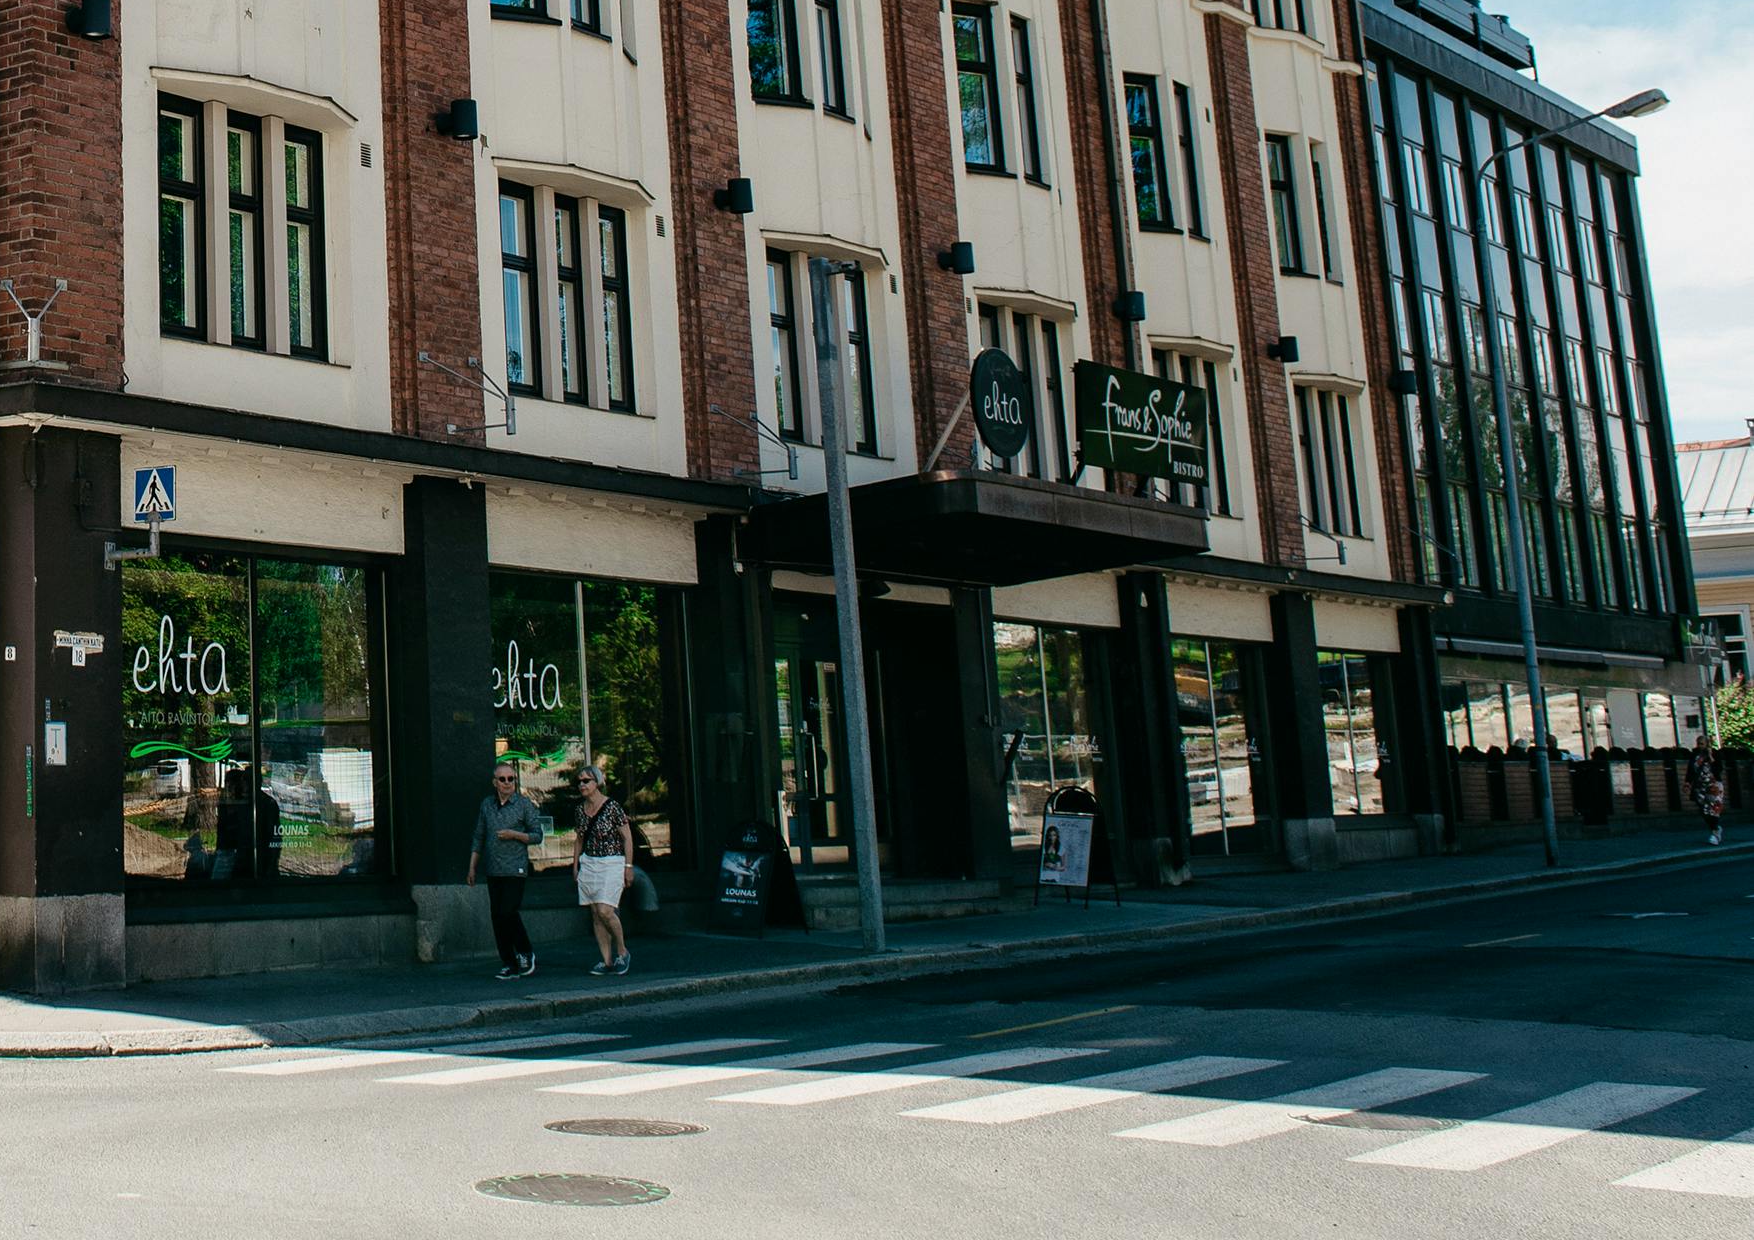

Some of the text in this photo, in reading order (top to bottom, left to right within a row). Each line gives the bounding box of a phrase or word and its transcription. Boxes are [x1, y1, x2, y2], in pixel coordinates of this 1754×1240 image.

[984, 381, 1023, 425] ehta
[1134, 389, 1192, 464] Sophie
[1173, 461, 1203, 479] BISTRO
[7, 648, 13, 659] 8
[75, 650, 82, 663] 18
[133, 615, 231, 695] ehta
[141, 711, 221, 726] AITO RAVINTOLA
[273, 824, 309, 836] LOUNAS
[725, 888, 757, 898] LOUNAS
